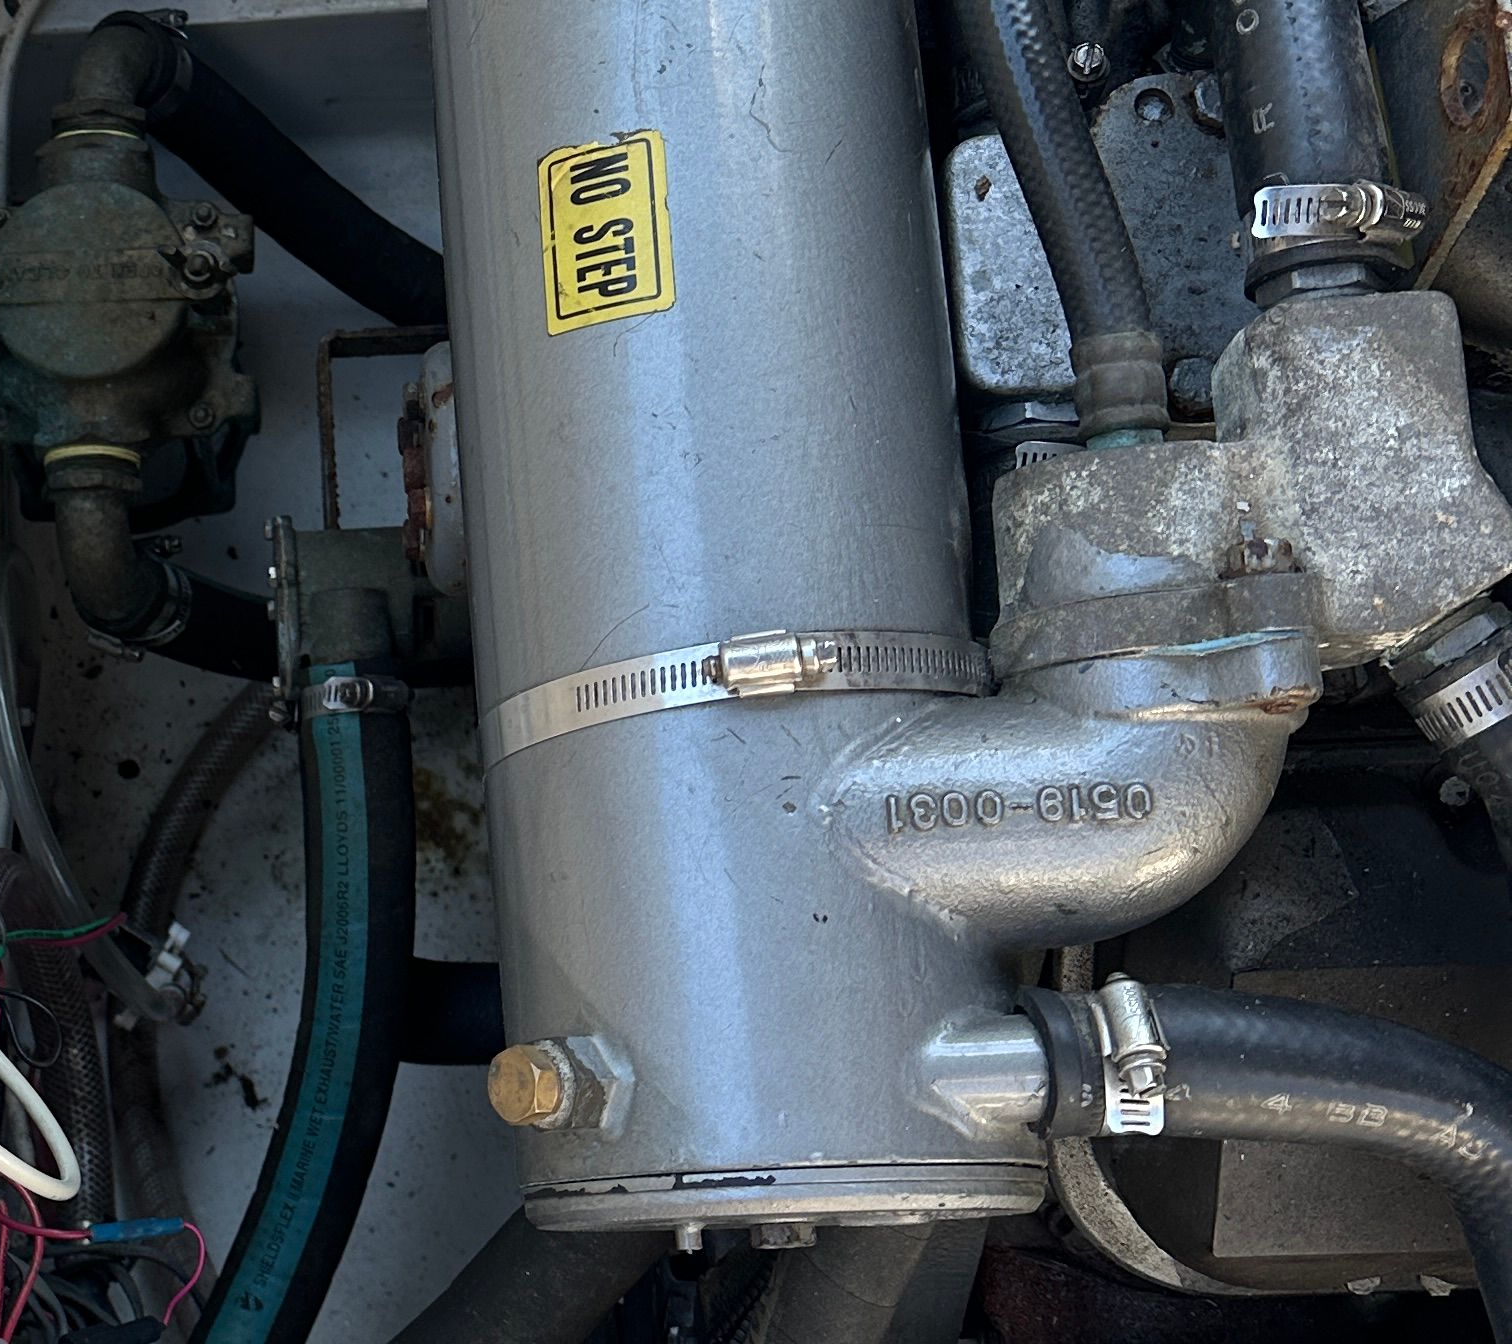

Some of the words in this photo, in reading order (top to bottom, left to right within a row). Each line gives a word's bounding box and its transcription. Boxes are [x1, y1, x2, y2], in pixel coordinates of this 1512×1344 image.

[570, 152, 632, 205] NO
[573, 217, 637, 298] STEP
[884, 781, 1154, 834] 0519-0031
[336, 810, 350, 875] LLOYDS
[334, 950, 348, 980] SAE
[306, 1111, 324, 1145] WET
